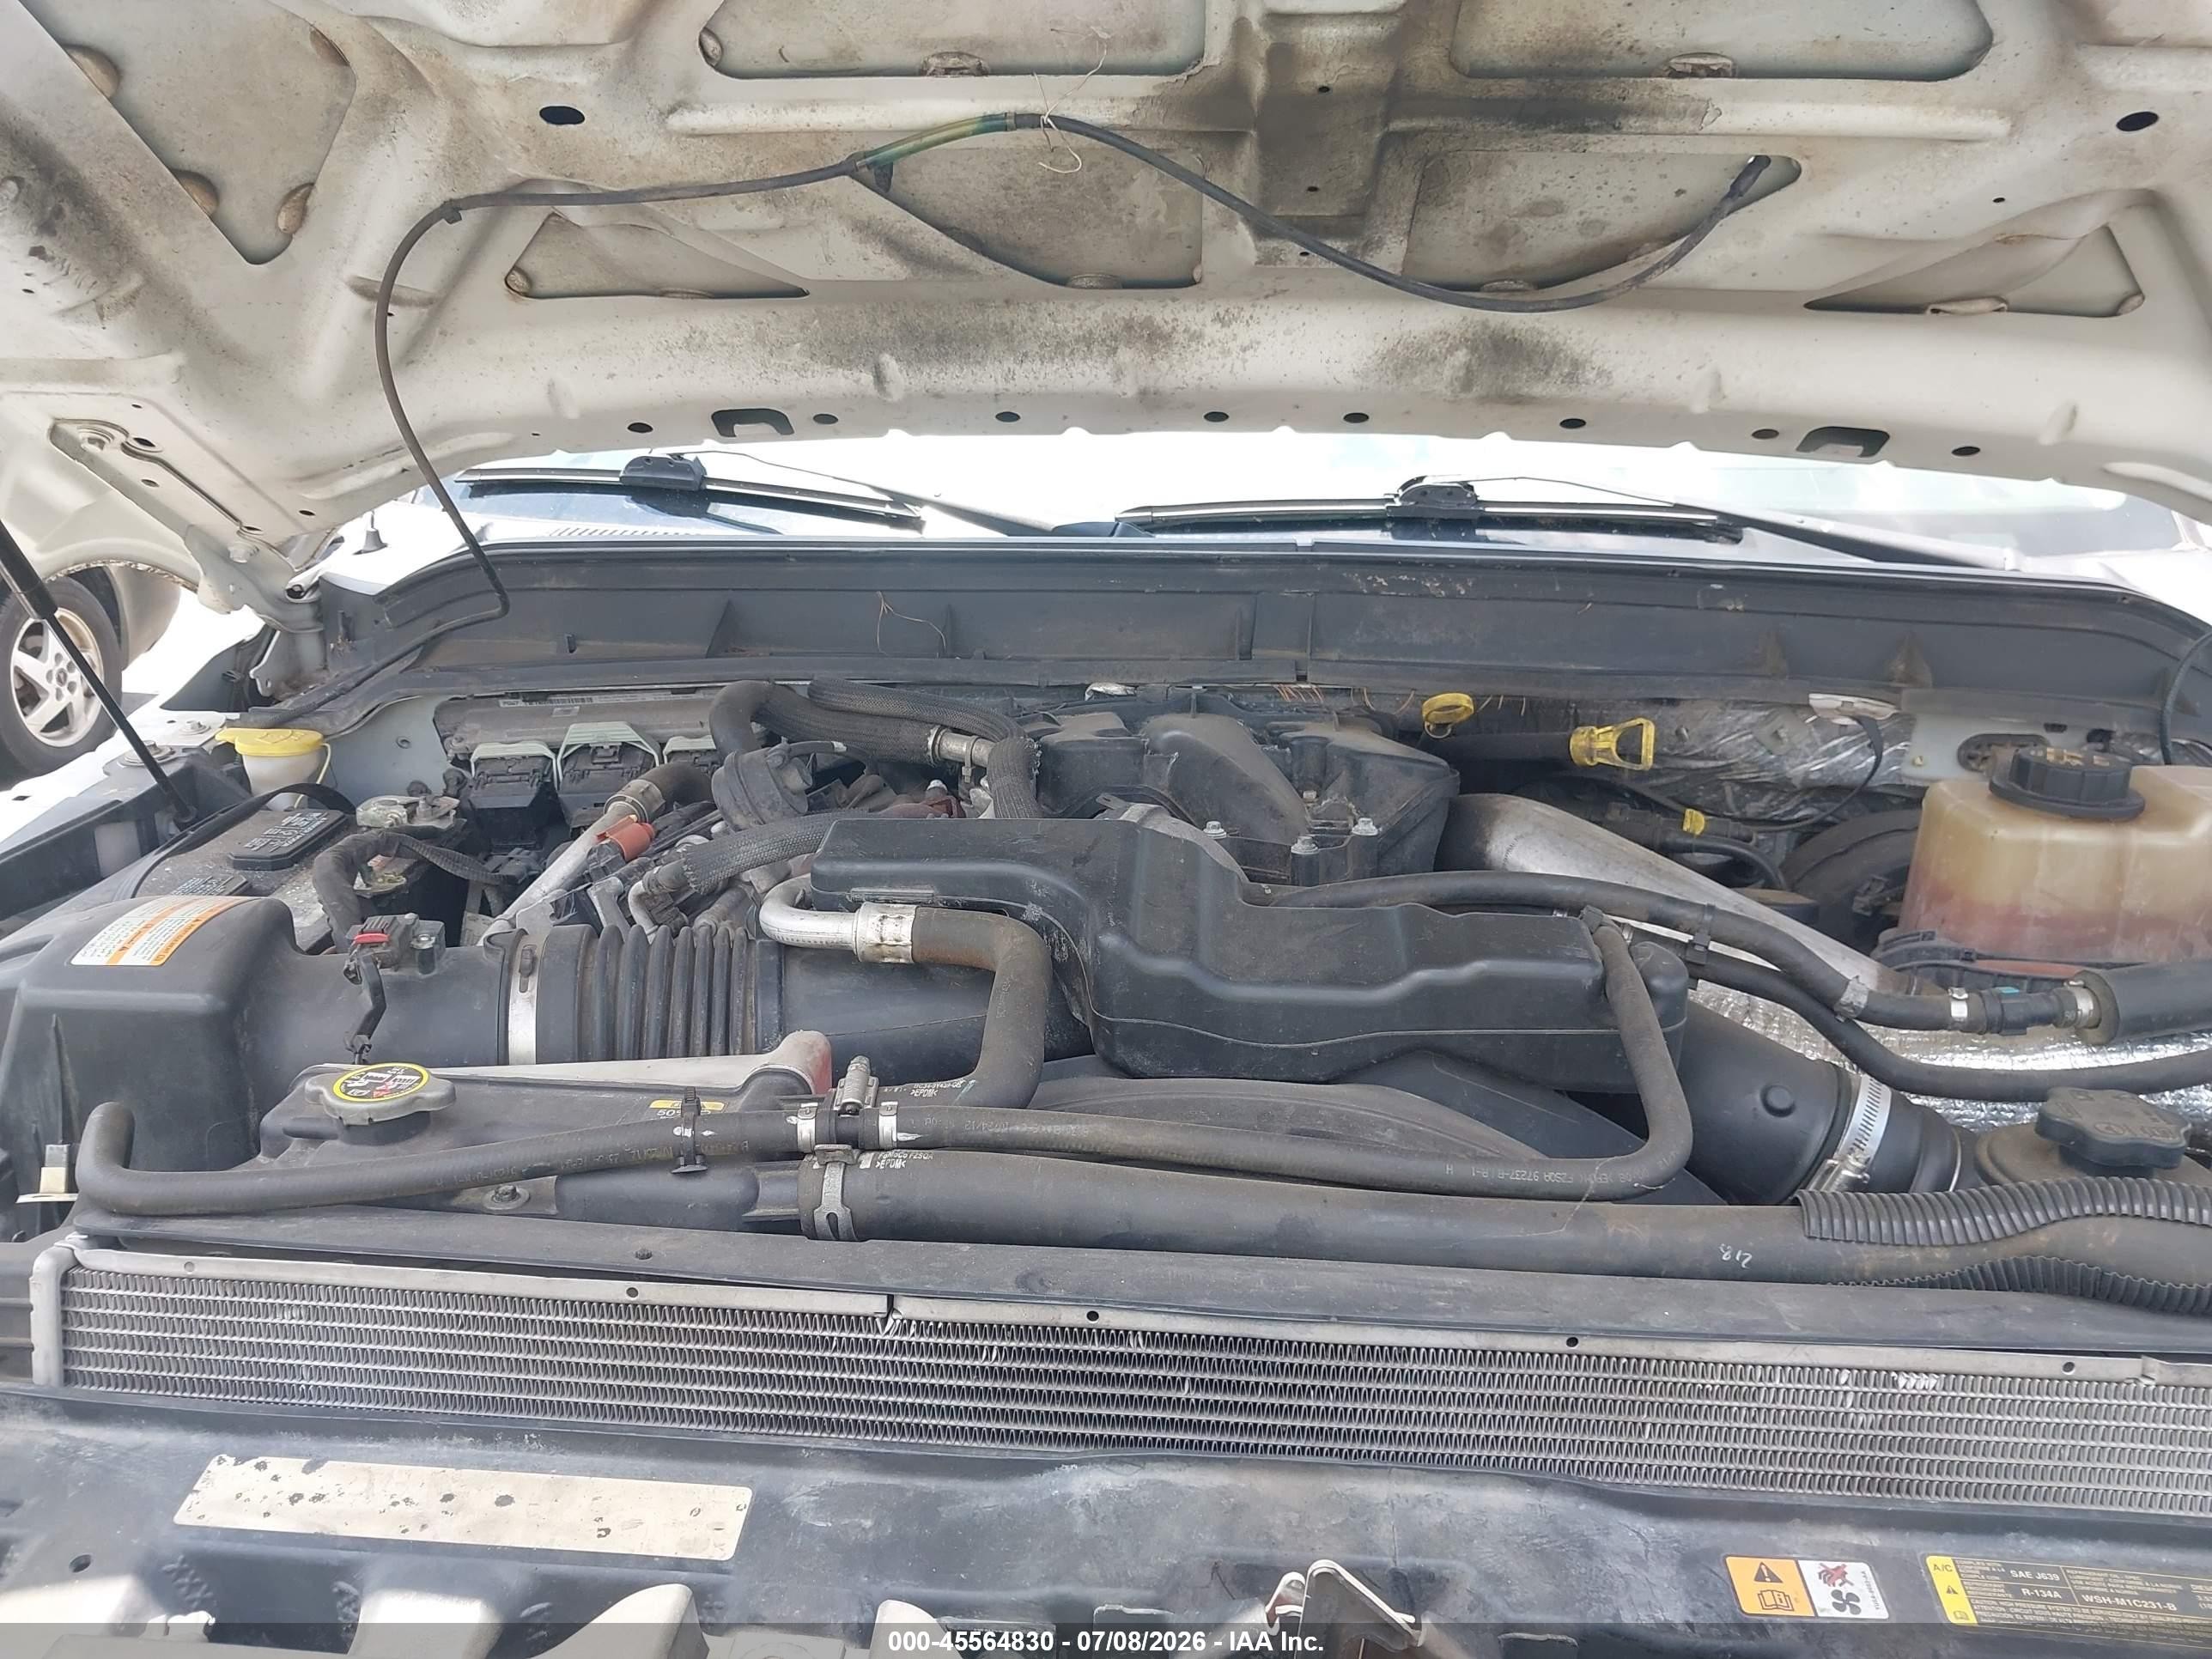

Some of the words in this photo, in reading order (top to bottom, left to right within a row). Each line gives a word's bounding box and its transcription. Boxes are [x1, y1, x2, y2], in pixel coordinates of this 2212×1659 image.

[1933, 1564, 1954, 1572] A/C
[2009, 1569, 2033, 1579] SAE
[2035, 1571, 2061, 1582] J639
[2021, 1588, 2063, 1599] R-134A
[2081, 1594, 2179, 1612] WSH-M1C231-B
